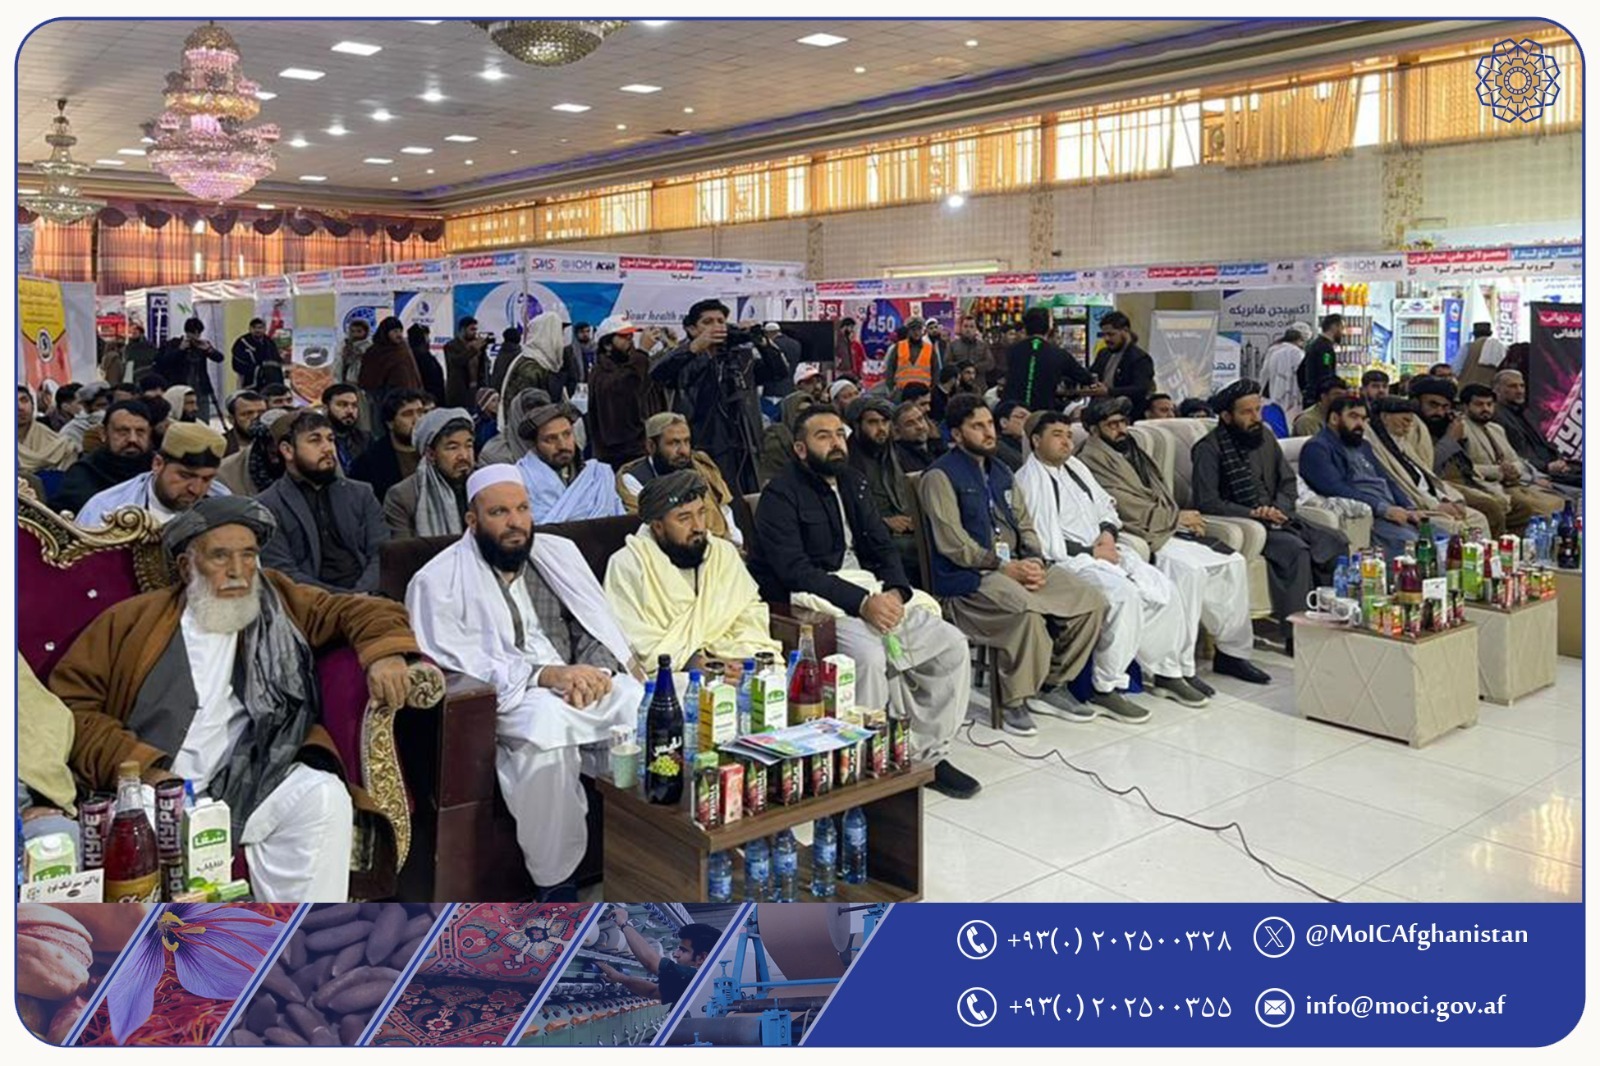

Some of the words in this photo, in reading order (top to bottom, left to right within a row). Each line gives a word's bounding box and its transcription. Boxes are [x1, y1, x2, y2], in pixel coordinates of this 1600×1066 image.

[571, 260, 592, 270] IOM
[1353, 260, 1376, 270] IOM
[649, 310, 676, 320] health
[867, 315, 896, 333] 450
[1500, 301, 1514, 345] HYPE
[160, 798, 175, 849] HYPE
[84, 813, 102, 867] HYPE
